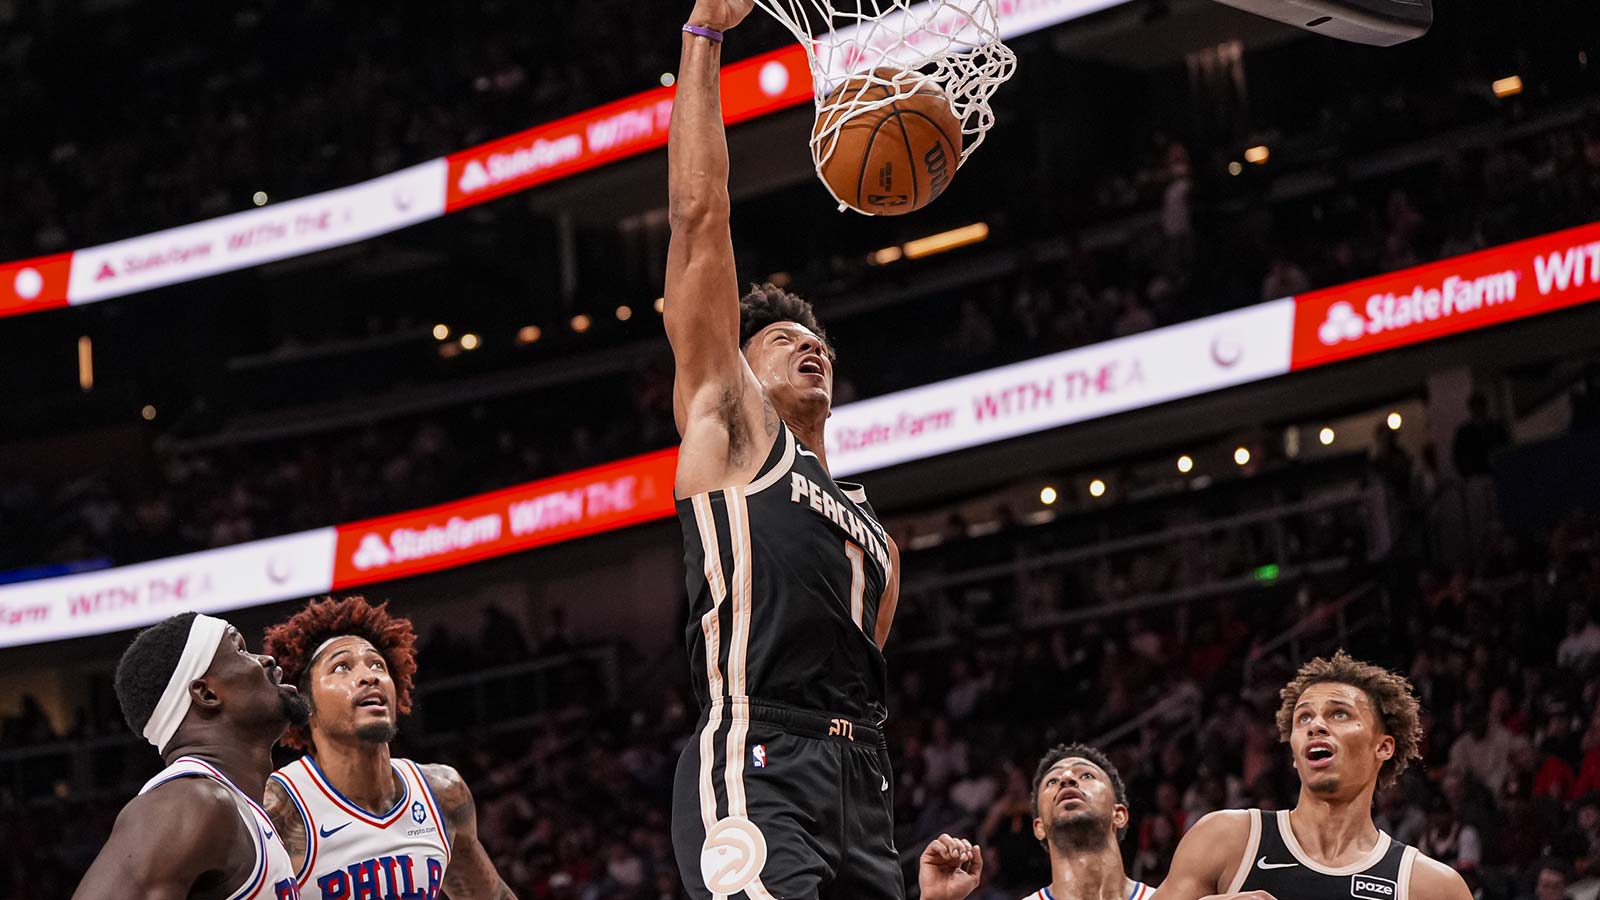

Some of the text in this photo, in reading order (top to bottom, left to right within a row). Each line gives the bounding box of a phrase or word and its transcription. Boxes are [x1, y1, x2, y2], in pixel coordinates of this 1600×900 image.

[972, 377, 1055, 423] WITH
[1063, 362, 1118, 403] THE
[508, 487, 585, 536] WITH
[586, 475, 637, 518] THE
[844, 539, 866, 632] 1
[828, 718, 855, 742] ATL
[407, 825, 438, 837] crypto.com
[1355, 880, 1393, 895] paze
